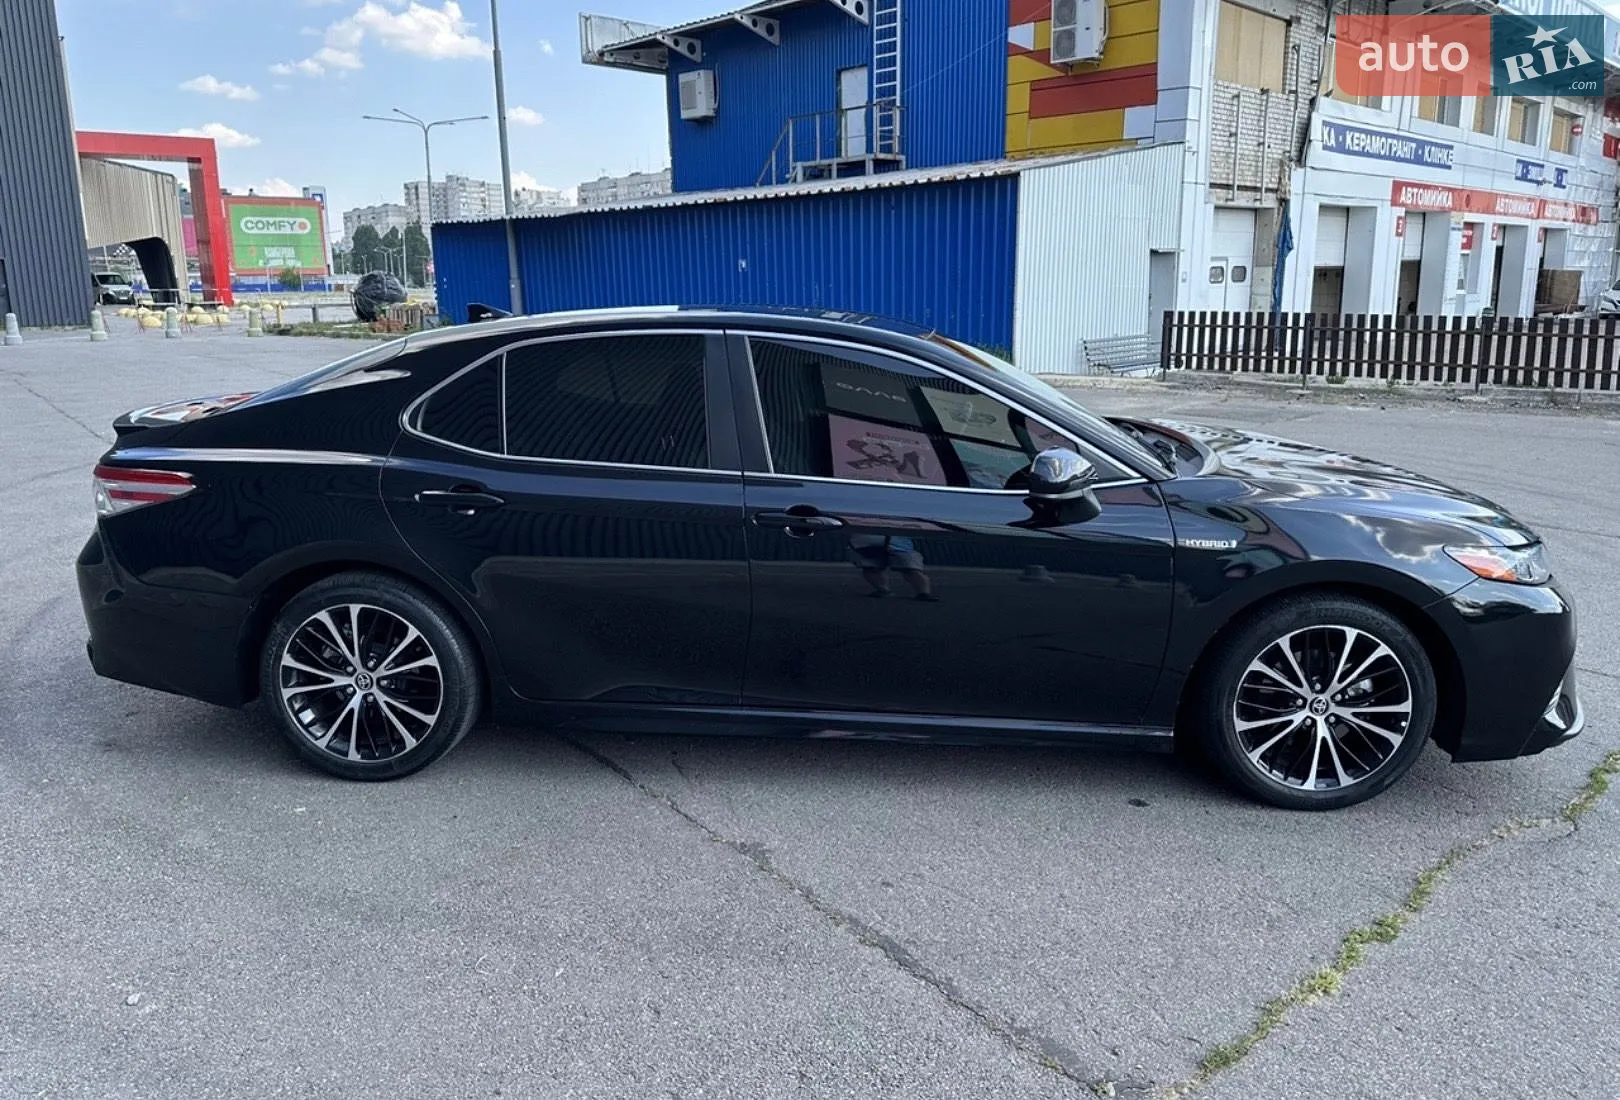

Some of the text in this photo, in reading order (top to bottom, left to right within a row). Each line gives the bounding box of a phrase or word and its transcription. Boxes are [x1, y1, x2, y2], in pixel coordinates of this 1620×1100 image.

[1345, 130, 1416, 160] КЕРАМОГРАНІТ
[1400, 186, 1453, 208] АВТОМИЙКА
[244, 219, 297, 231] COMFY
[1186, 539, 1229, 549] HYBRID
